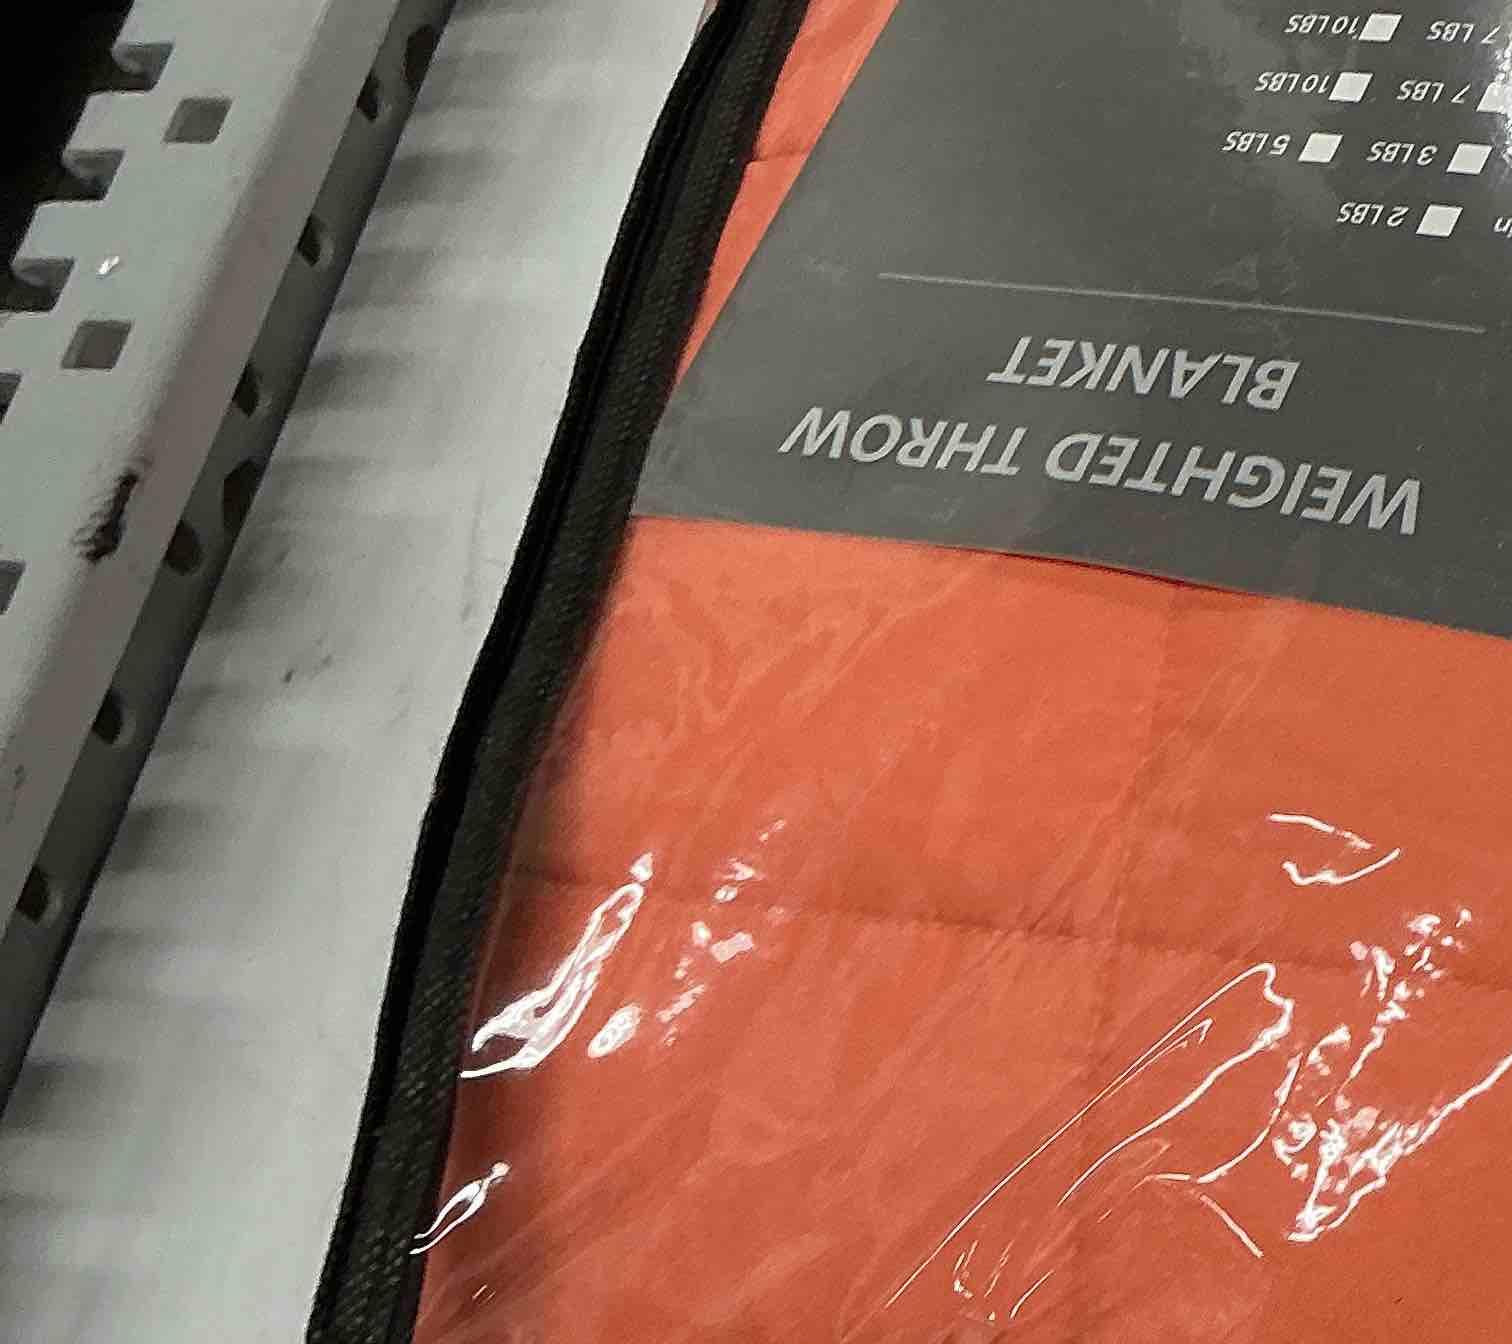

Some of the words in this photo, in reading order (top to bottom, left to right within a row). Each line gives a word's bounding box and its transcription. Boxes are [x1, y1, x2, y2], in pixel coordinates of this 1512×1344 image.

[1283, 13, 1330, 34] LBS
[1329, 14, 1360, 34] 10
[1425, 19, 1474, 43] LBS
[1479, 23, 1502, 44] 7
[1253, 70, 1300, 93] LBS
[1301, 74, 1331, 94] 10
[1395, 79, 1444, 104] LBS
[1449, 82, 1471, 104] 7
[1221, 130, 1269, 154] LBS
[1268, 133, 1290, 155] 5
[1365, 140, 1415, 164] LBS
[1416, 144, 1439, 166] 3
[1335, 201, 1384, 225] LBS
[1385, 205, 1409, 227] 2
[985, 335, 1300, 410] BLANKET
[777, 406, 1028, 476] THROW
[1044, 431, 1422, 535] WEIGHTED
